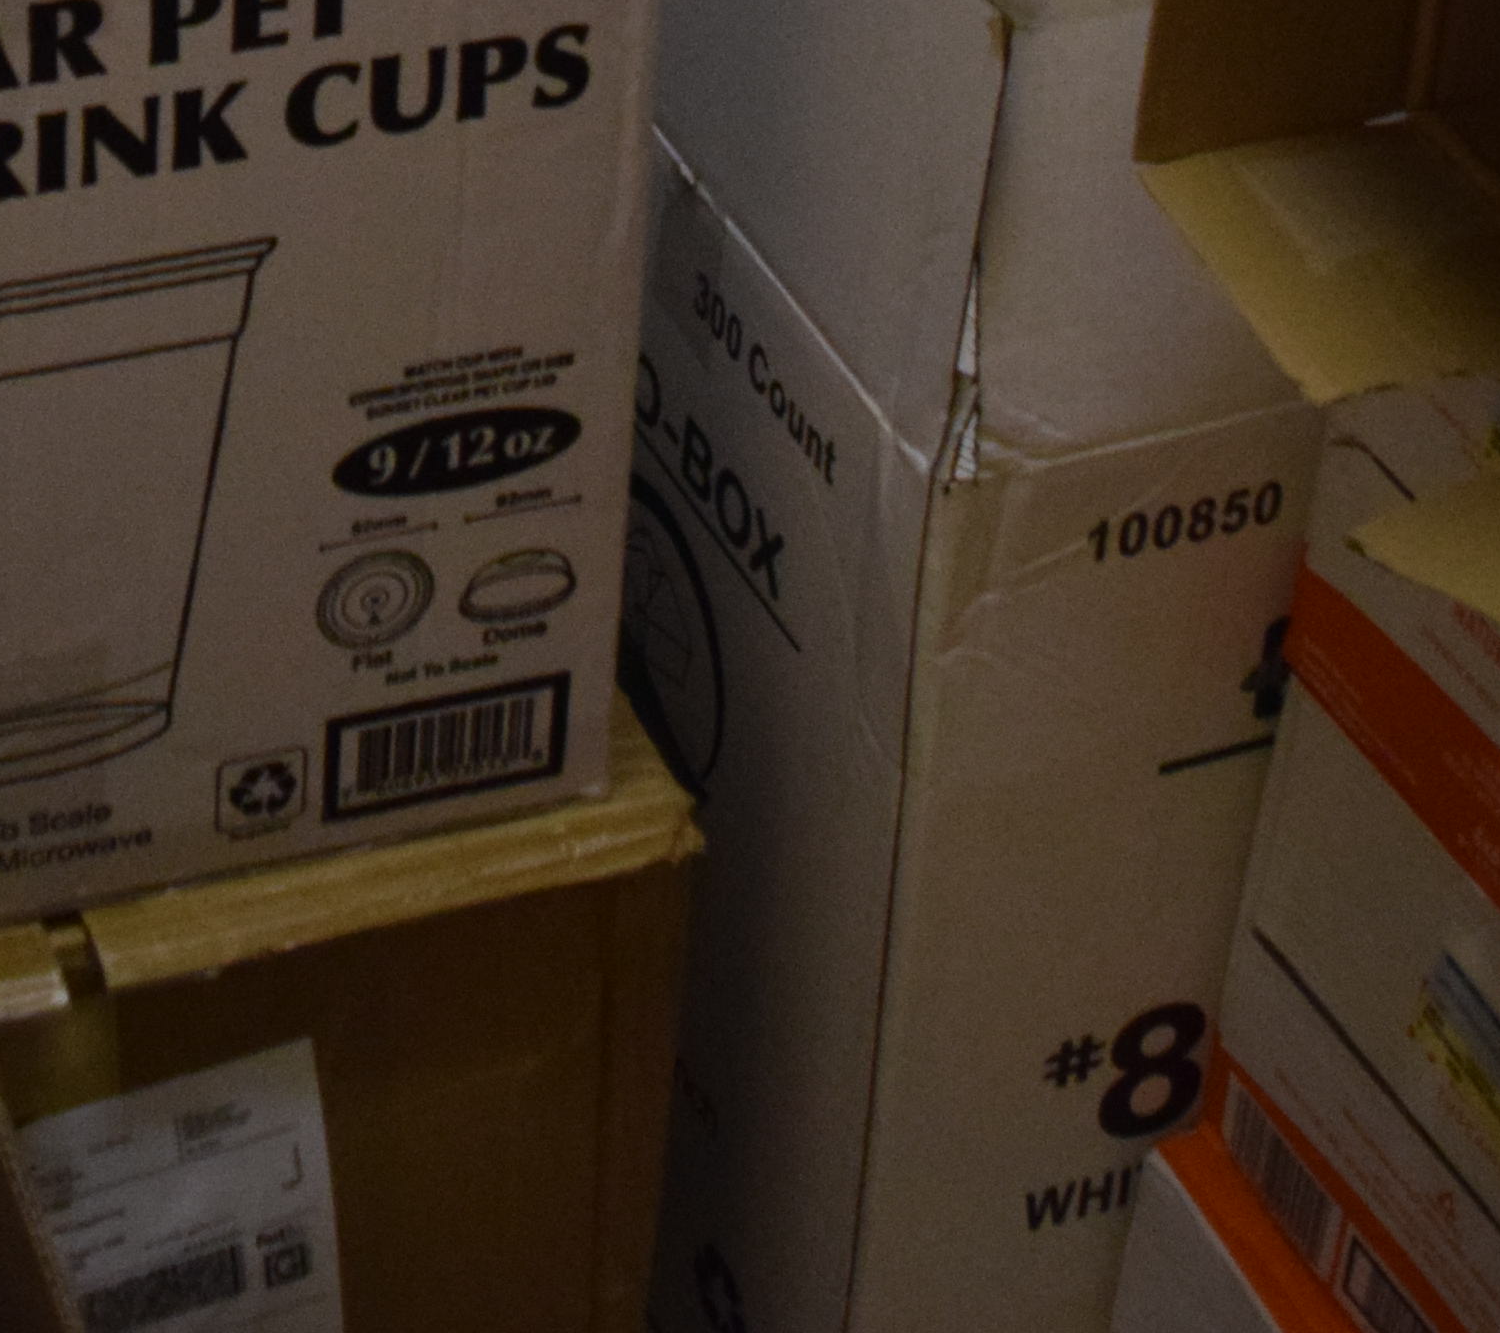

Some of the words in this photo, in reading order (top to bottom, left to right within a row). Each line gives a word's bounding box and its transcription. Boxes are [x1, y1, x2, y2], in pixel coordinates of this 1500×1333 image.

[283, 23, 594, 144] CUPS
[692, 271, 742, 363] 300
[748, 344, 838, 488] Count
[1087, 480, 1284, 564] 100850
[351, 650, 394, 673] Flat
[27, 800, 113, 839] Scale
[1043, 1001, 1208, 1139] #8
[1023, 1163, 1143, 1232] WHI
